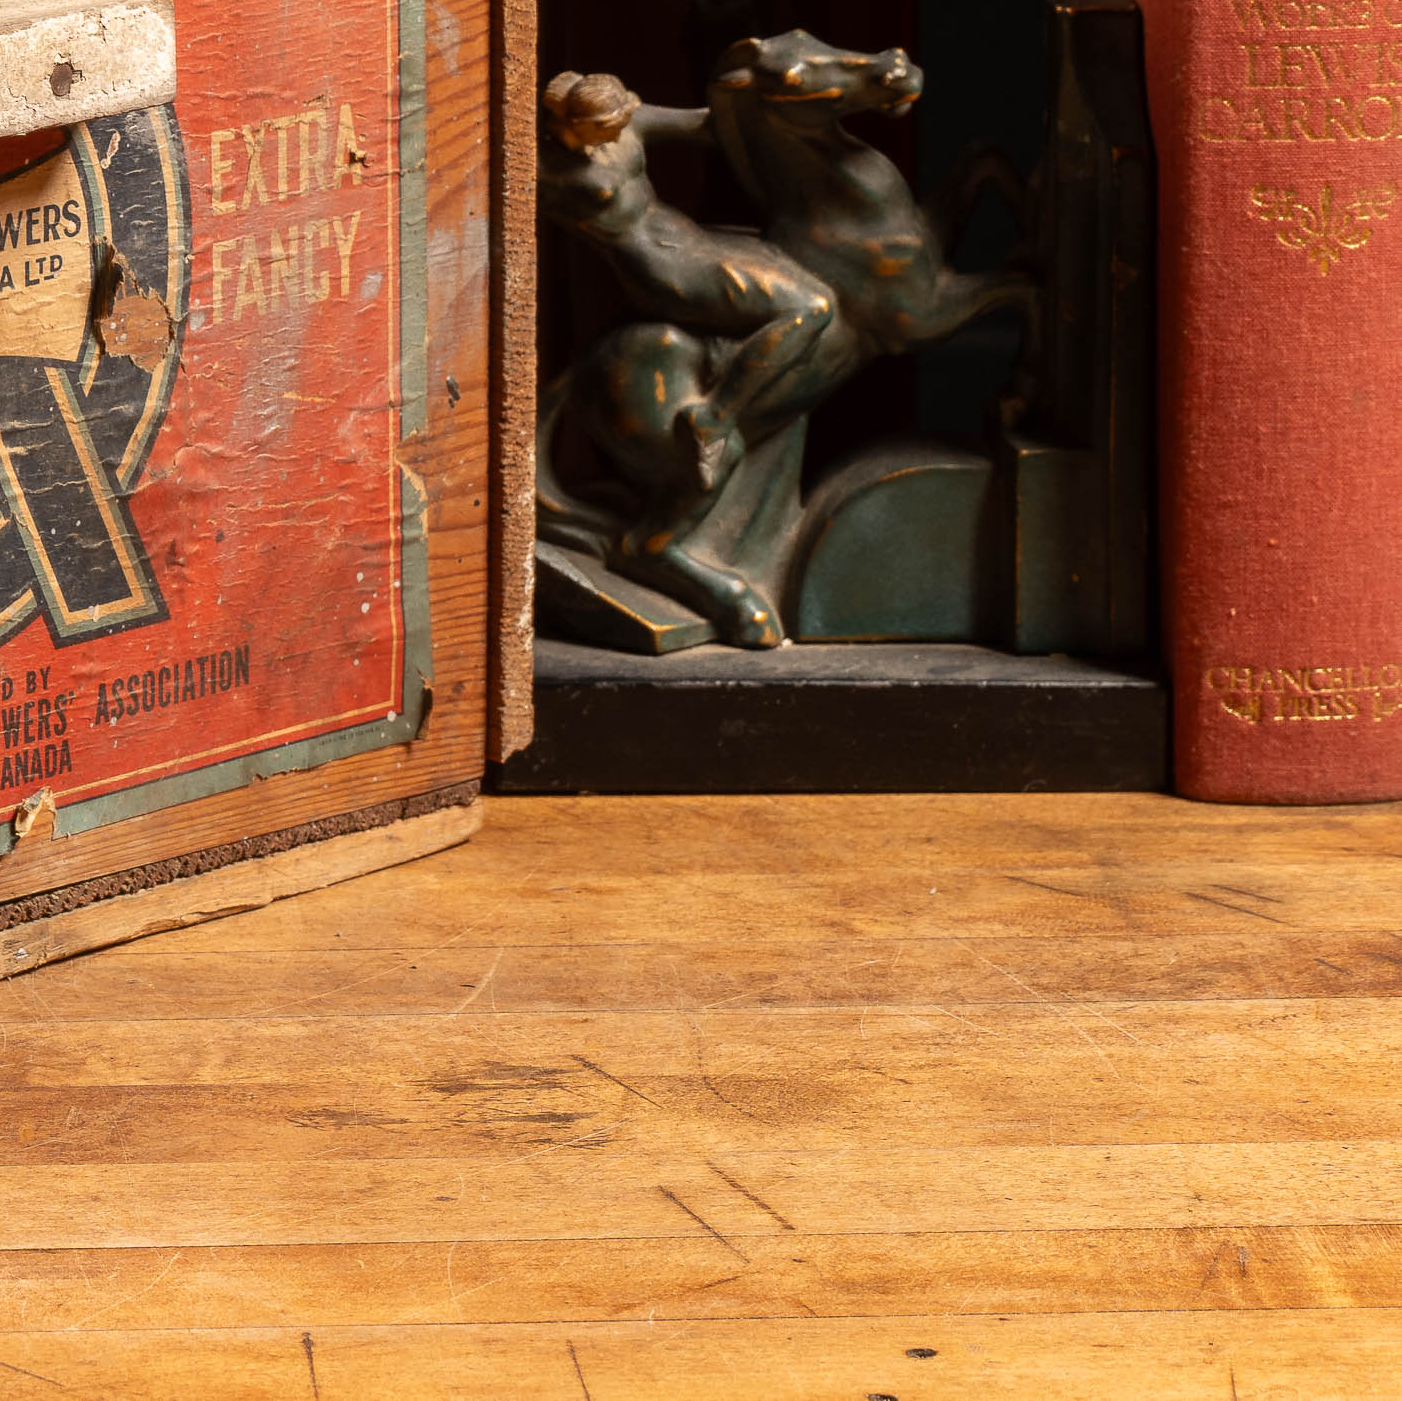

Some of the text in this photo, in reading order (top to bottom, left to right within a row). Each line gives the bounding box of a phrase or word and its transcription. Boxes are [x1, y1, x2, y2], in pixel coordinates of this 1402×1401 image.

[210, 102, 364, 217] EXTRA
[211, 210, 362, 325] FANCY
[25, 666, 52, 694] BY
[94, 645, 252, 726] ASSOCIATION
